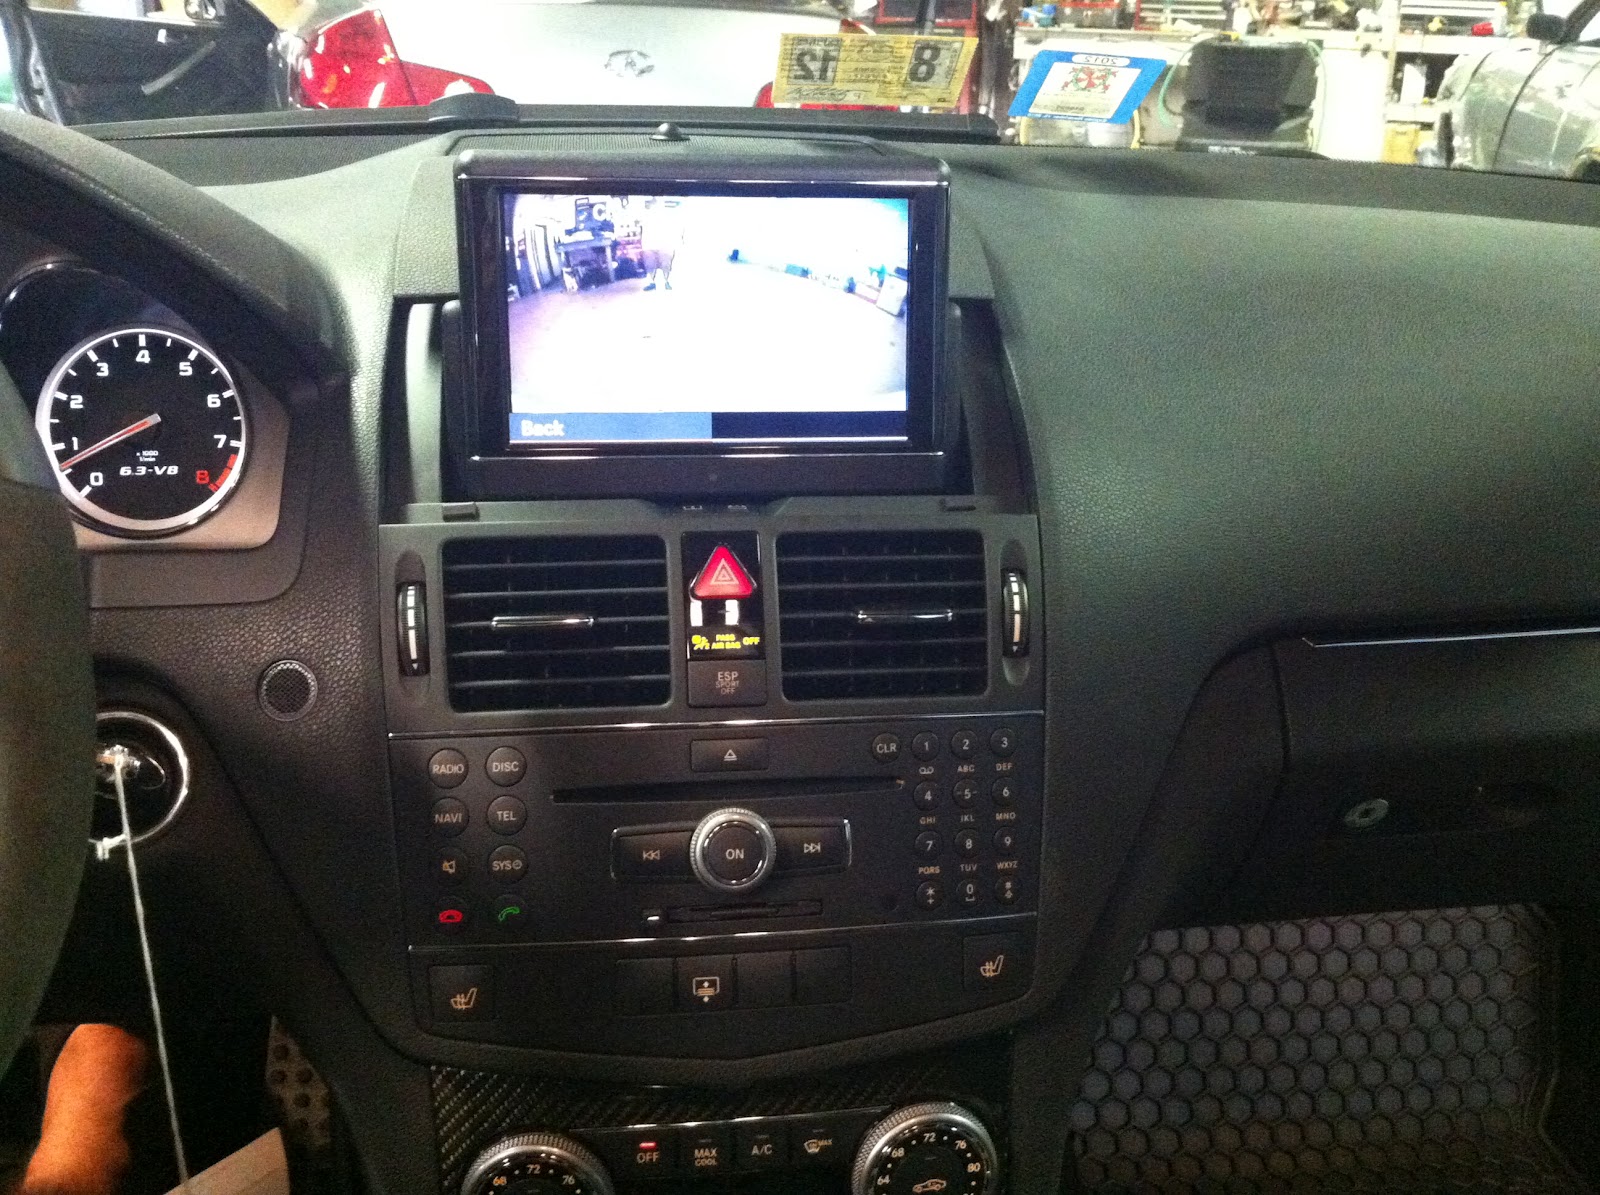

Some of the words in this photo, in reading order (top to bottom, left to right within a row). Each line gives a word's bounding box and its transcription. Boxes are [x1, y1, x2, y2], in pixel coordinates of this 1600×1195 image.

[136, 350, 150, 364] 4
[96, 362, 109, 377] 3
[179, 362, 193, 376] 5
[70, 395, 84, 409] 2
[207, 394, 221, 408] 6
[521, 419, 565, 436] Back
[72, 437, 79, 450] 1
[213, 435, 227, 448] 7
[119, 465, 179, 476] 6.3-V8
[89, 472, 103, 486] 0
[196, 470, 209, 484] 8
[717, 671, 739, 681] ESP
[715, 680, 739, 688] SPORT
[720, 687, 736, 695] OFF
[923, 741, 930, 751] 1
[962, 739, 970, 750] 2
[1001, 737, 1008, 748] 3
[876, 743, 897, 754] CLR
[432, 763, 465, 775] RADIO
[492, 761, 519, 773] DISC
[957, 764, 975, 773] ABC
[995, 762, 1013, 771] DEF
[924, 790, 932, 801] 4
[964, 788, 972, 800] 5
[1002, 786, 1010, 797] 6
[434, 813, 462, 823] NAVI
[496, 810, 517, 822] TEL
[919, 816, 936, 825] GHI
[960, 814, 975, 823] JKL
[995, 811, 1016, 821] MNO
[925, 840, 933, 851] 7
[965, 838, 973, 849] 8
[1004, 836, 1012, 847] 9
[725, 848, 745, 860] ON
[918, 865, 941, 875] PQRS
[960, 863, 978, 872] TUV
[996, 860, 1019, 870] WXYZ
[966, 883, 974, 894] 0
[923, 1132, 937, 1143] 72
[751, 1144, 773, 1156] A/C
[954, 1139, 967, 1150] 76
[636, 1152, 660, 1164] OFF
[694, 1147, 718, 1159] MAX
[891, 1147, 905, 1158] 68
[694, 1158, 718, 1167] COOL
[967, 1162, 981, 1173] 80
[526, 1164, 541, 1175] 72
[492, 1176, 507, 1187] 68
[562, 1175, 575, 1185] 76
[877, 1174, 890, 1186] 64
